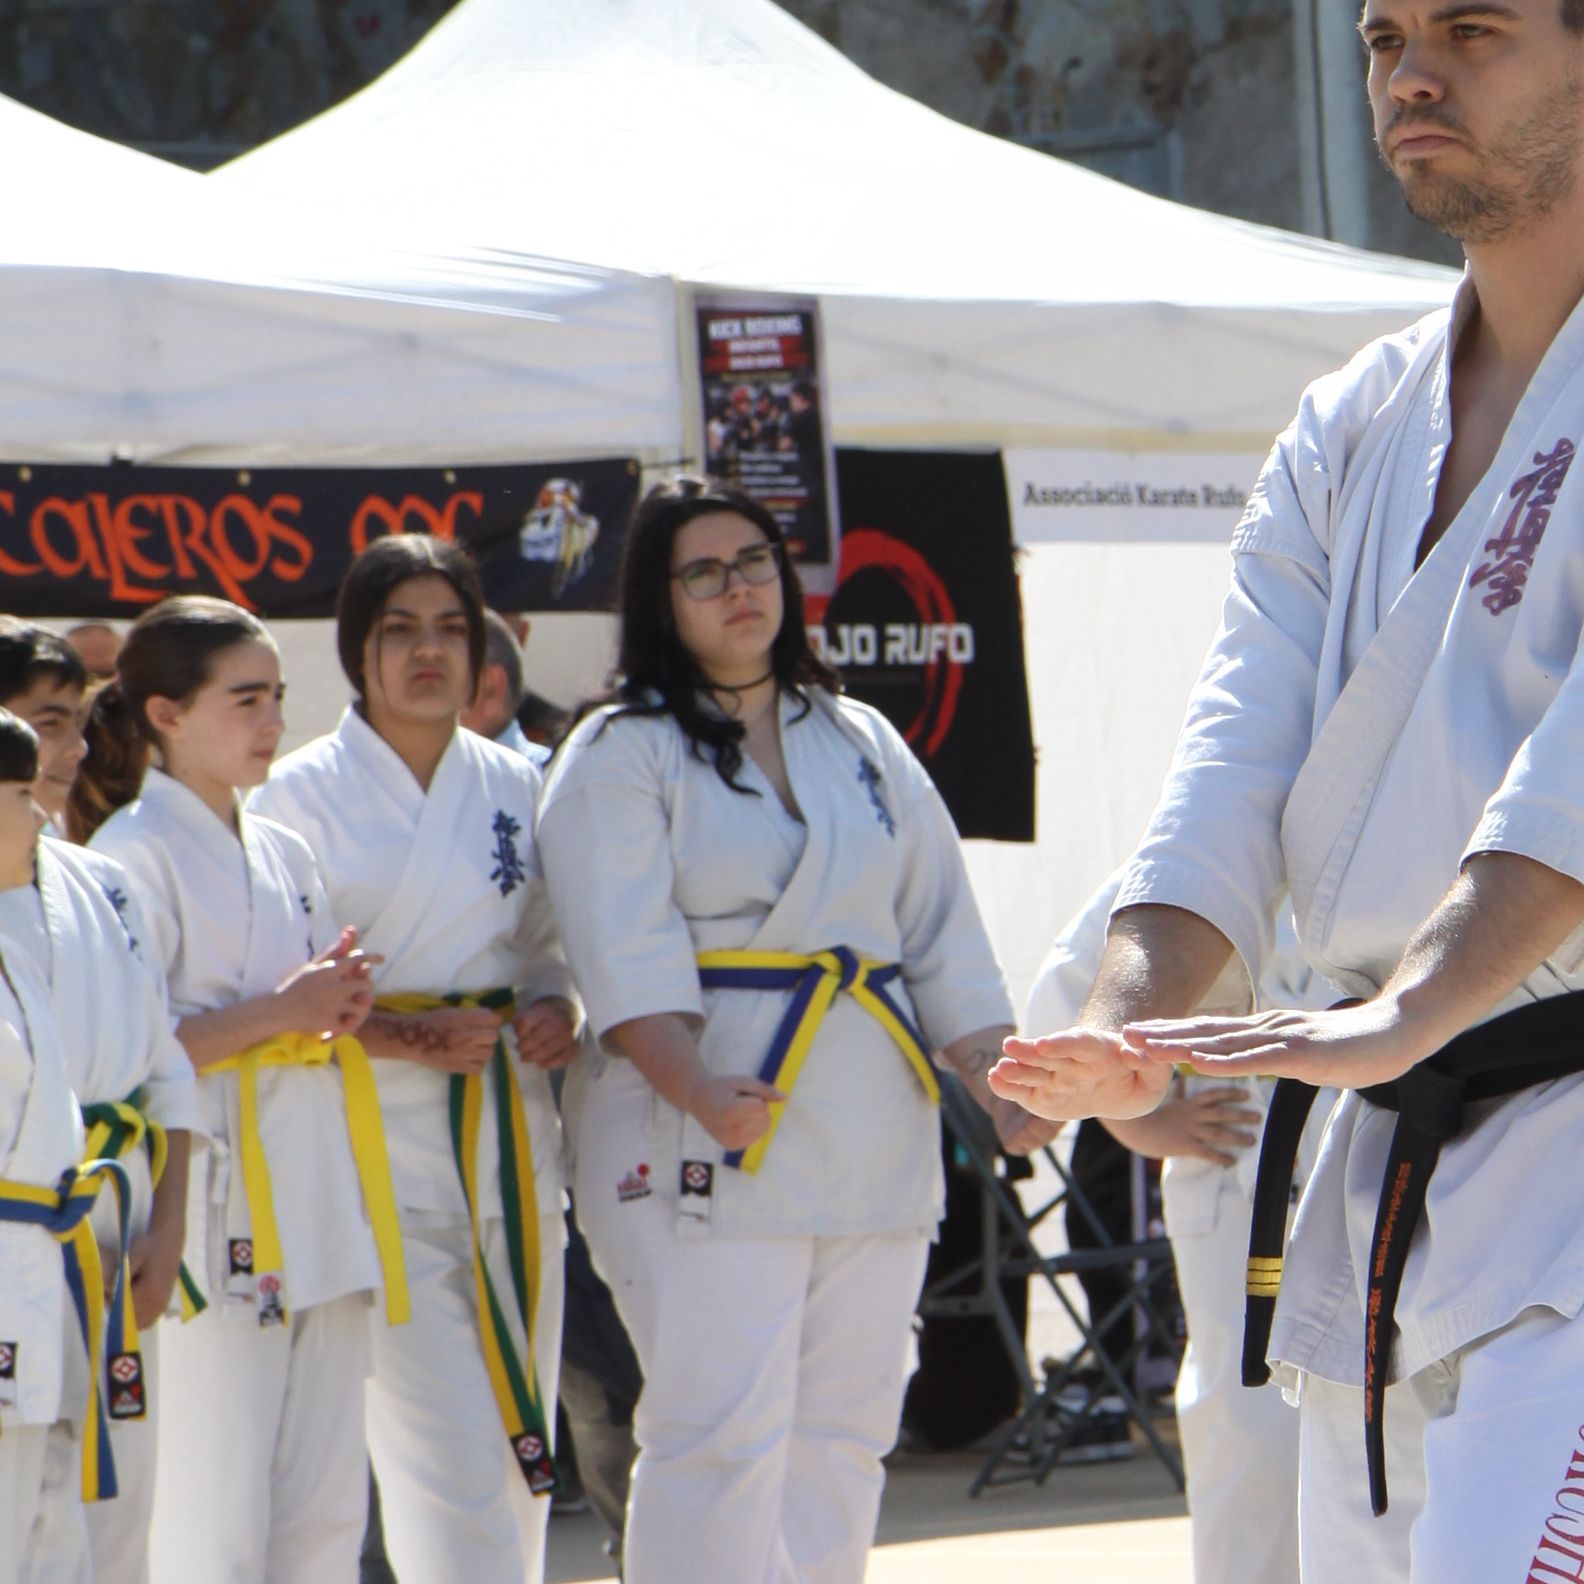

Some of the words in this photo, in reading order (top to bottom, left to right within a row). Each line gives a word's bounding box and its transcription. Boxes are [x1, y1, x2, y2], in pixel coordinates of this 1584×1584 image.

[1135, 482, 1198, 507] Karate
[804, 623, 878, 666] OJO
[884, 621, 975, 665] RUFO
